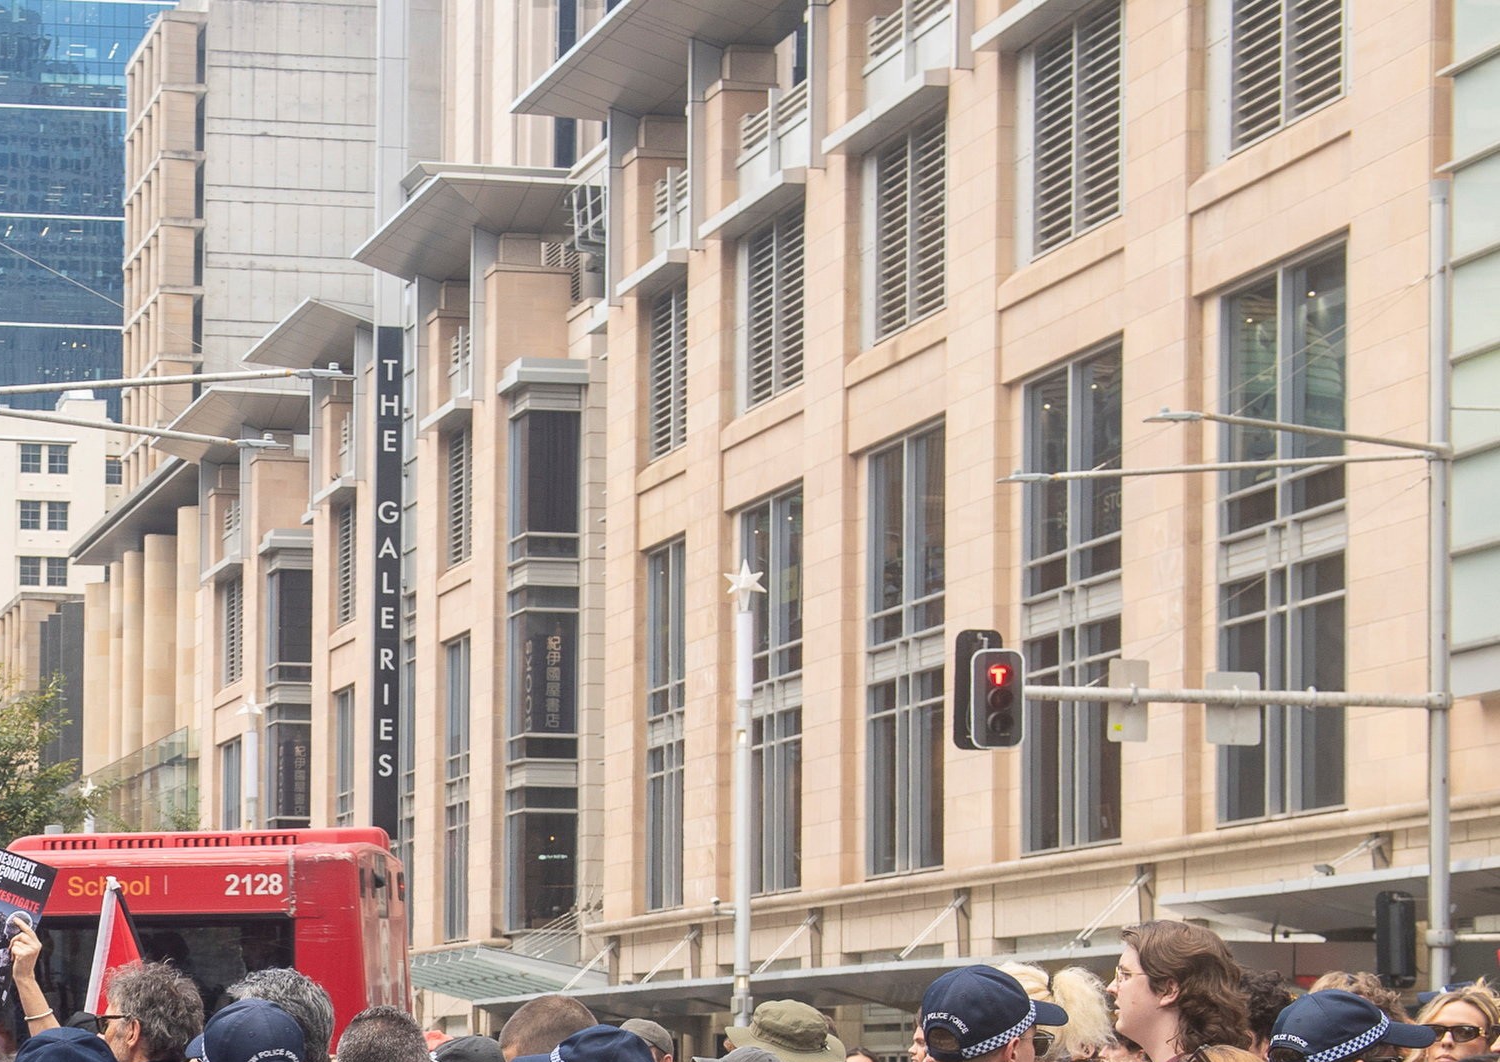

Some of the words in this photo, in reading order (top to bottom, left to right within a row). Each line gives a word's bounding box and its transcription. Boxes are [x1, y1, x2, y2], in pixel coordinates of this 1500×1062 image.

[380, 359, 399, 453] THE
[377, 500, 399, 779] GALERIES
[224, 873, 284, 896] 2128
[927, 1011, 948, 1020] POLICE
[948, 1015, 969, 1034] FORCE
[1287, 1034, 1308, 1048] FORCE
[258, 1048, 285, 1058] POLICE
